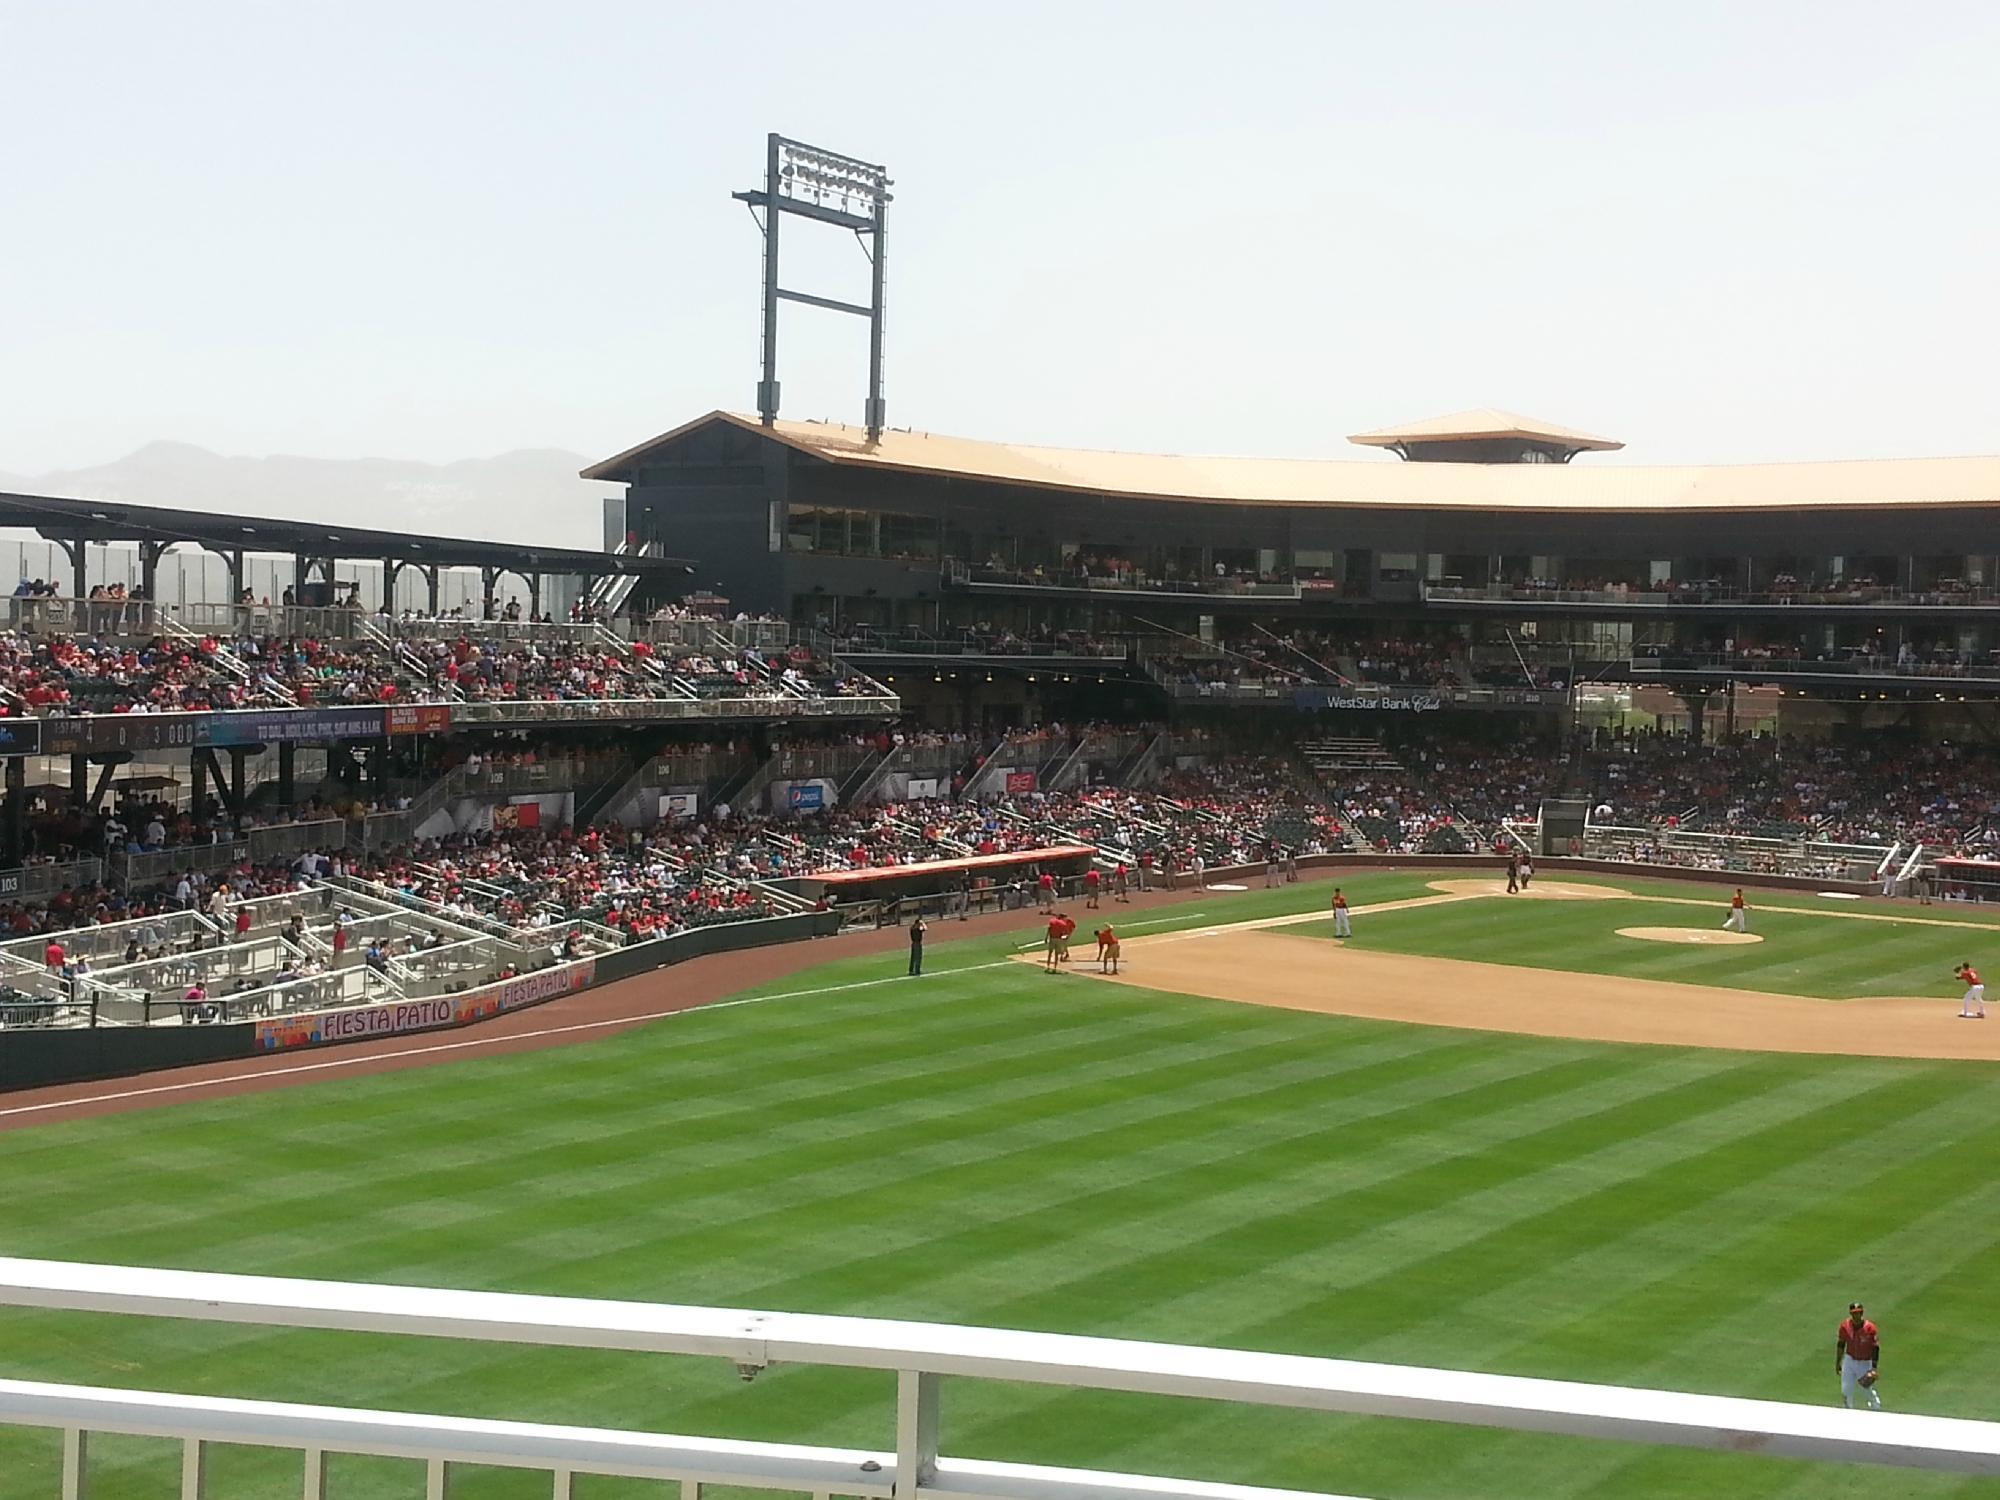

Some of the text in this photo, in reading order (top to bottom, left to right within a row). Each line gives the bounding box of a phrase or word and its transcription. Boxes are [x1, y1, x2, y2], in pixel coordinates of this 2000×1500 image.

[1327, 697, 1376, 709] WestStar
[1382, 697, 1410, 709] Bank
[86, 726, 93, 744] 4
[119, 727, 126, 746] 0
[154, 726, 160, 744] 3
[233, 848, 246, 860] 104
[1, 877, 17, 892] 103
[504, 969, 567, 1005] FIESTA PATIO
[324, 1001, 450, 1037] FIESTA PATIO
